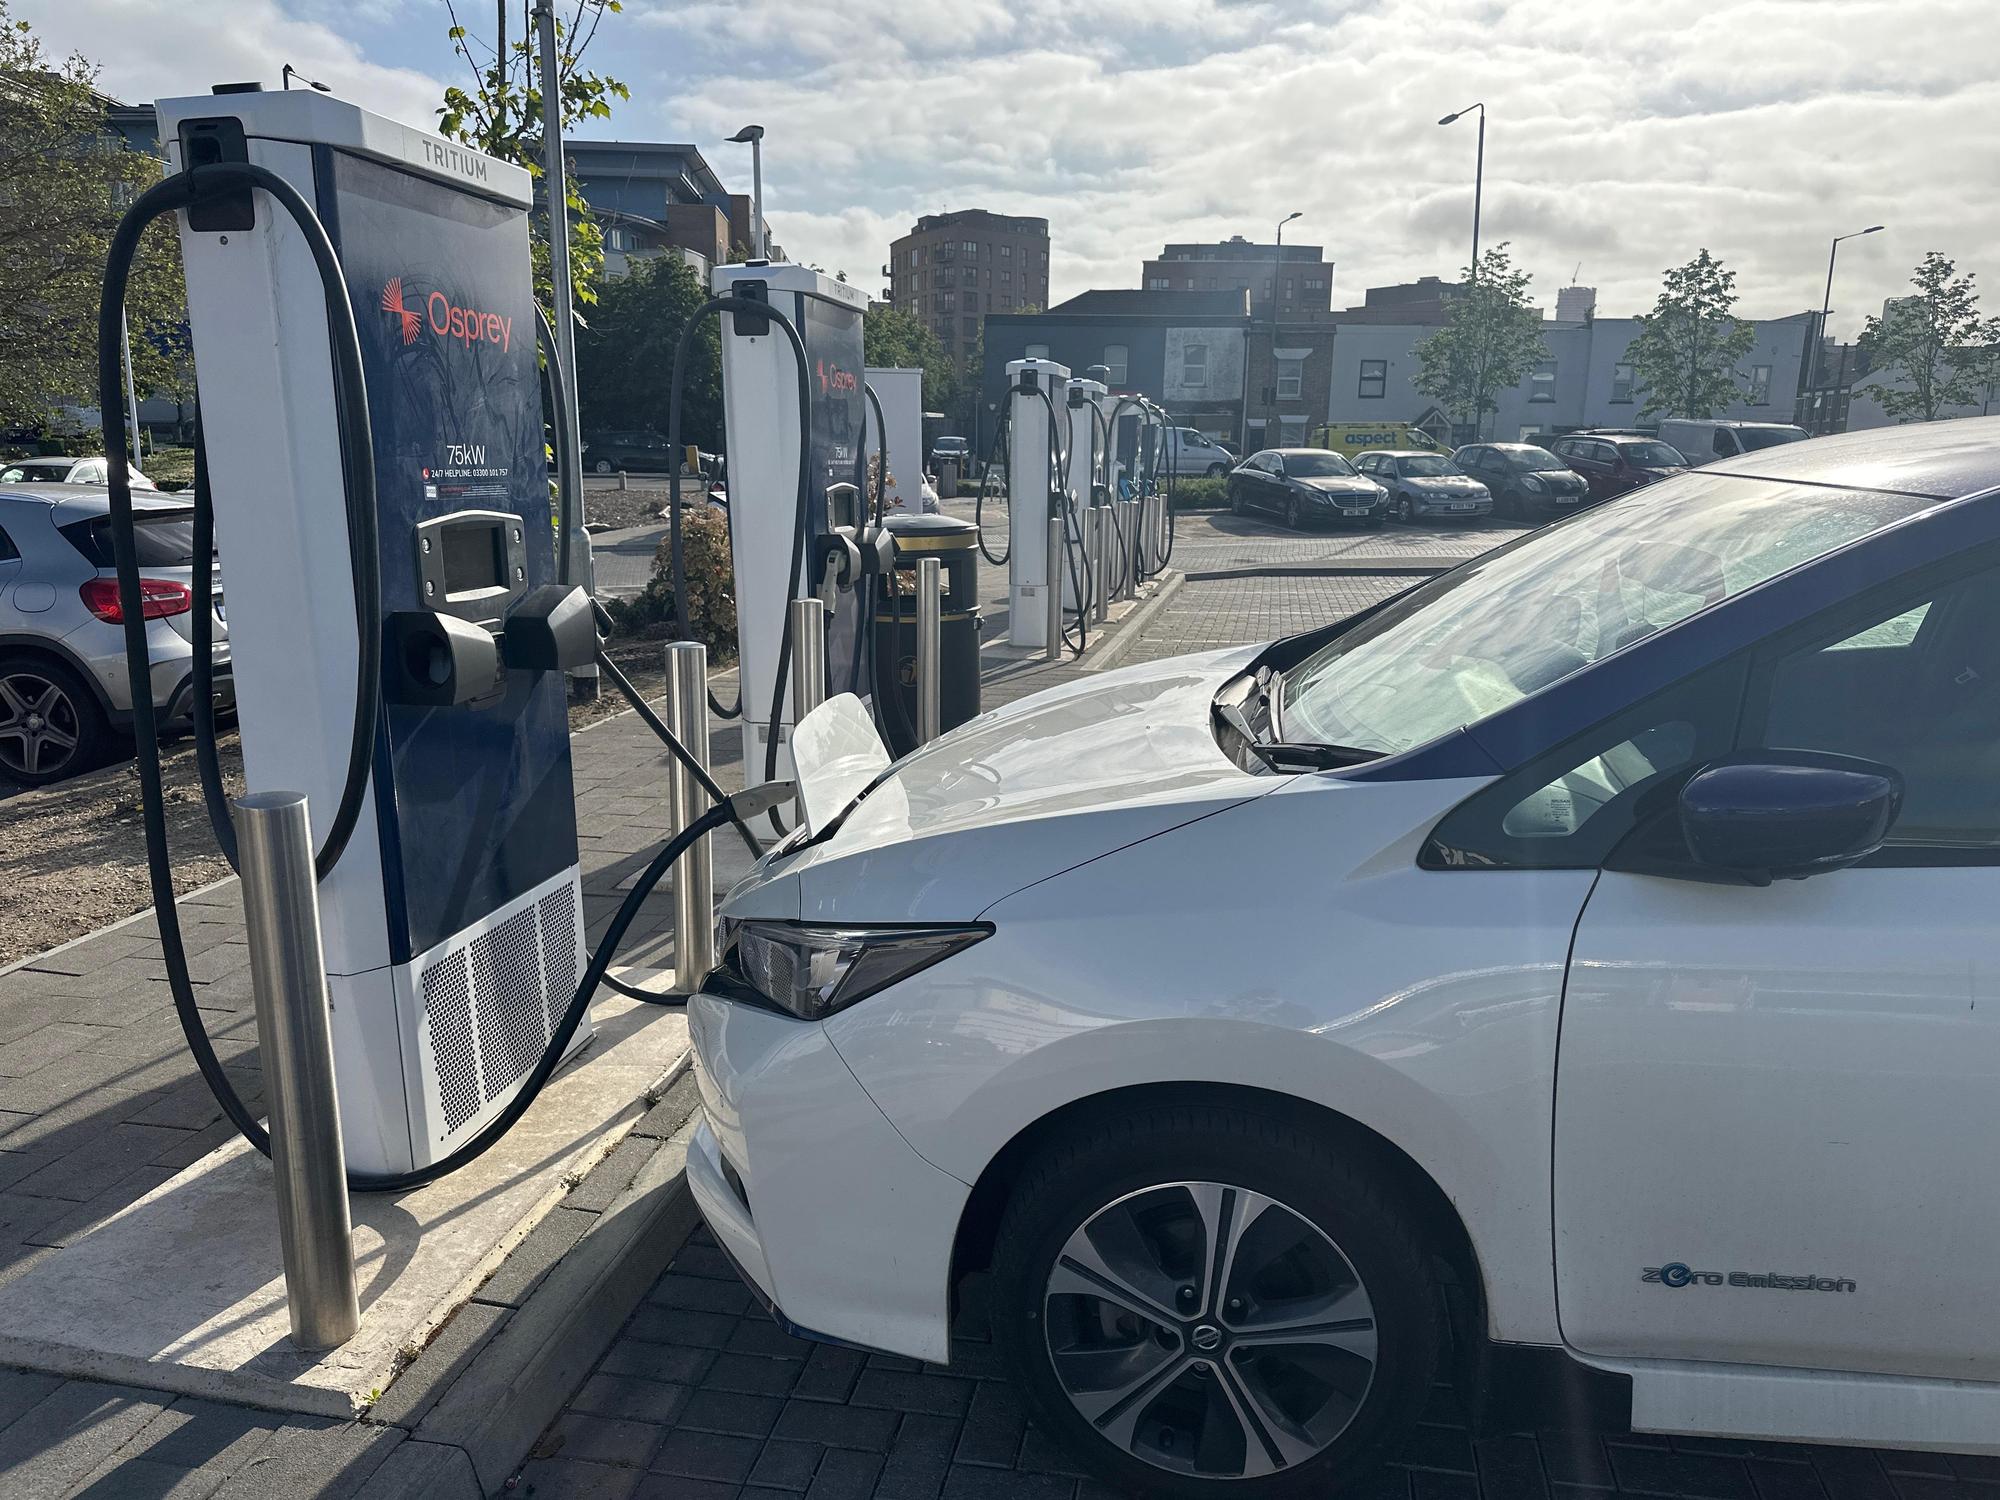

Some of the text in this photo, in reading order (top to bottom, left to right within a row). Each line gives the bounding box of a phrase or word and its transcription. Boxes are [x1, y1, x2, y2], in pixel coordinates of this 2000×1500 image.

[422, 140, 488, 182] TRITIUM
[428, 291, 512, 353] Osprey
[830, 363, 857, 398] Osprey
[1344, 431, 1397, 447] aspect
[446, 443, 485, 465] 75kW
[431, 469, 444, 478] 24/7
[472, 468, 489, 477] 03300
[489, 468, 499, 477] 101
[499, 468, 508, 477] 757
